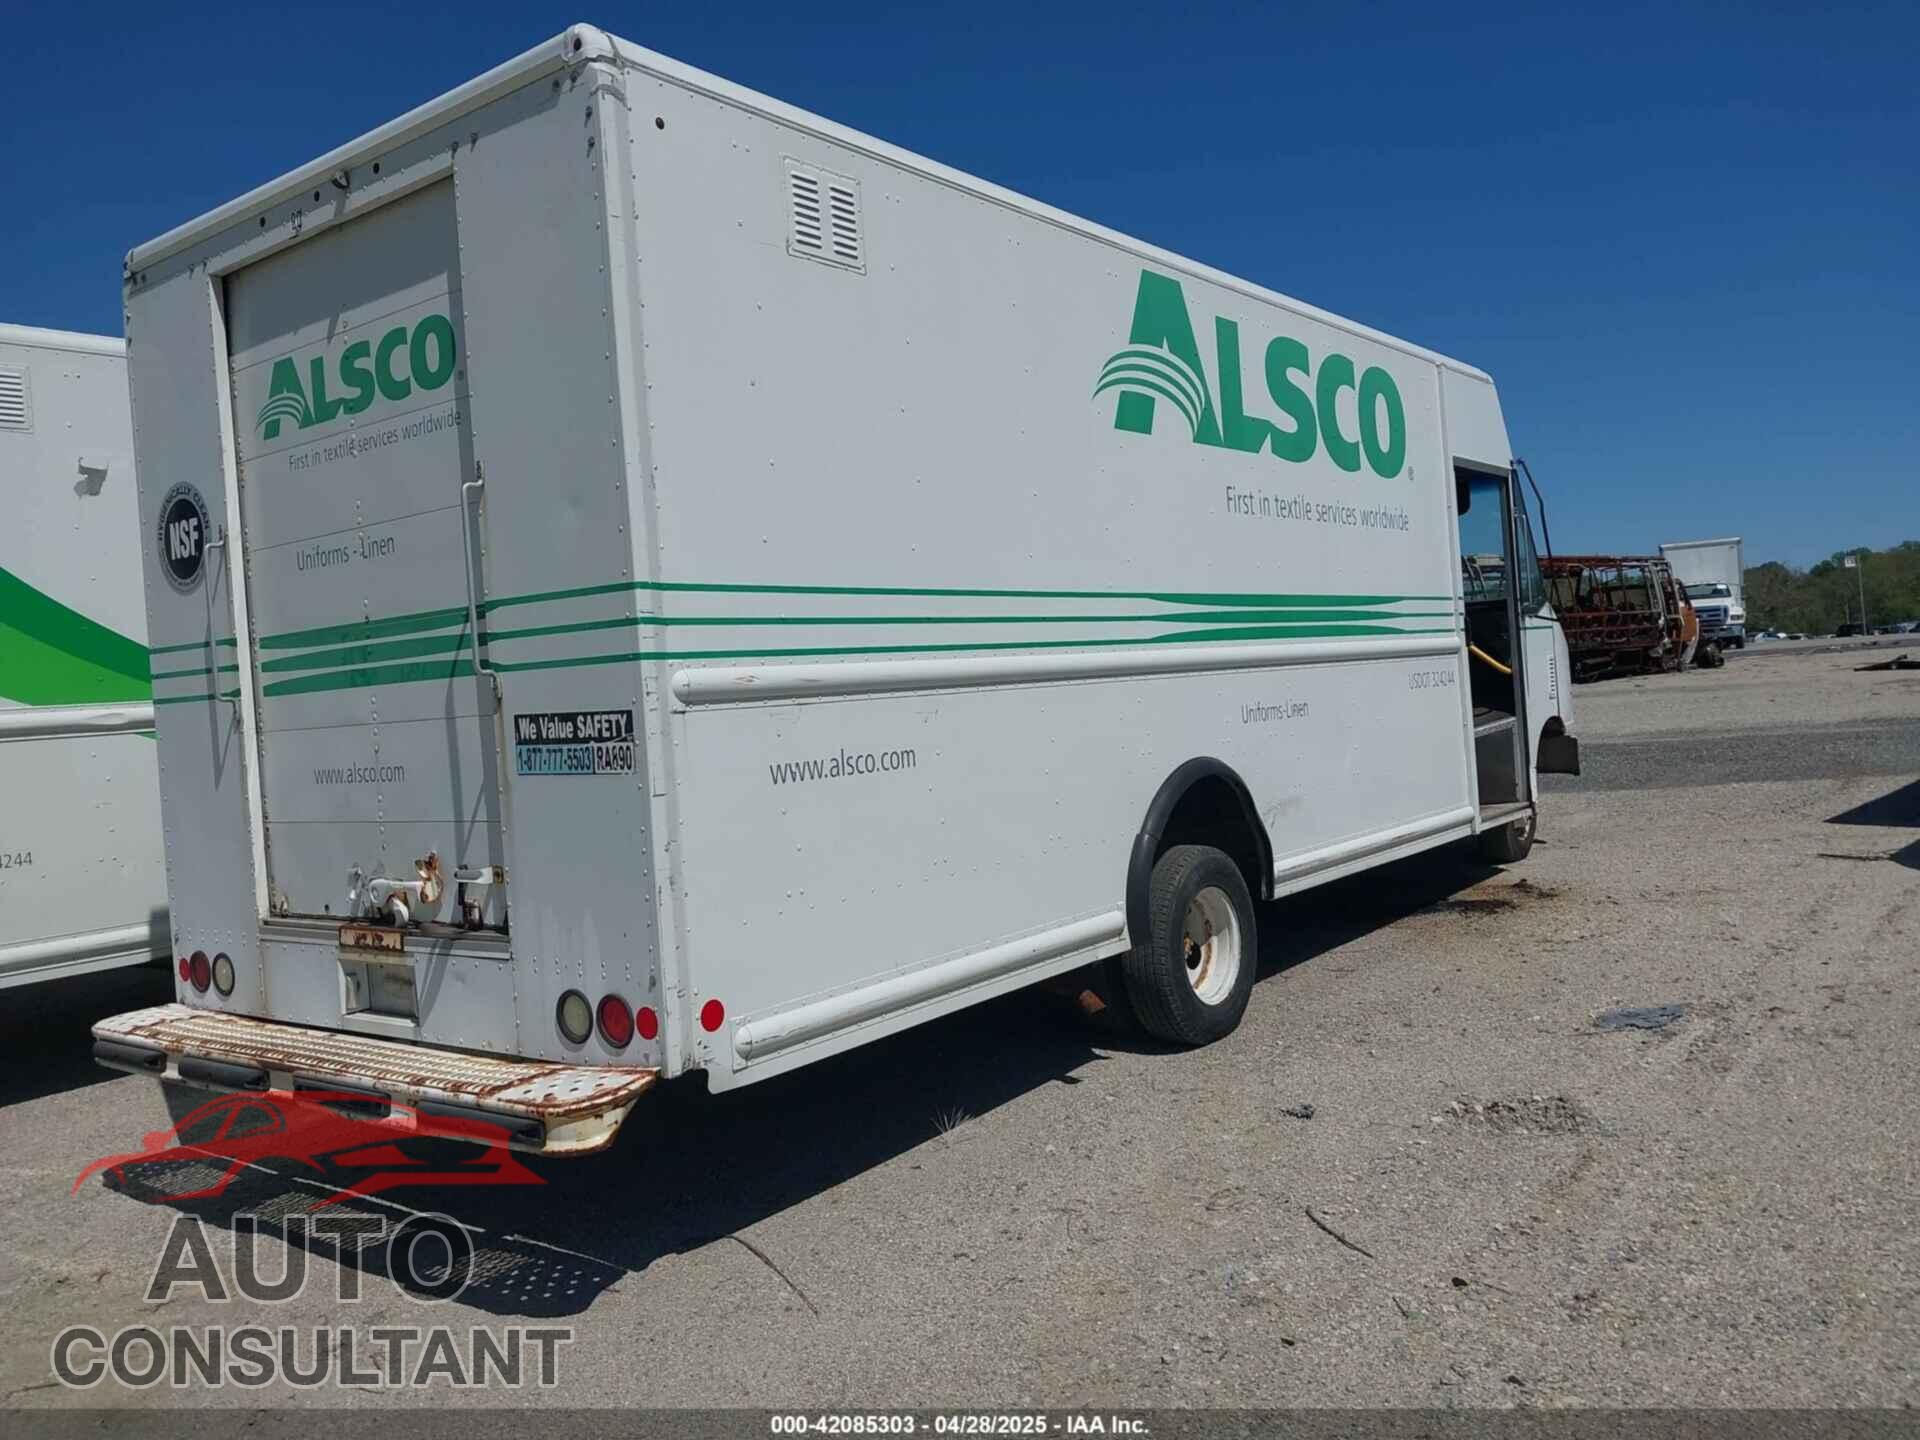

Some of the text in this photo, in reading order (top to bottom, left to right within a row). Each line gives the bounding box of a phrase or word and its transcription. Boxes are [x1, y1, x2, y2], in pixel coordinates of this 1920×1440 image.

[255, 313, 457, 441] ALSCO
[1092, 268, 1407, 480] ALSCO
[289, 408, 462, 471] First in textile services worldwide
[1225, 486, 1409, 532] First in textile services worldwide
[169, 517, 199, 561] NSF
[296, 545, 350, 571] Uniforms
[360, 536, 396, 560] Linen
[518, 713, 628, 740] We Value SAFETY
[313, 760, 406, 785] www.alsco.com
[769, 748, 917, 786] www.alsco.com
